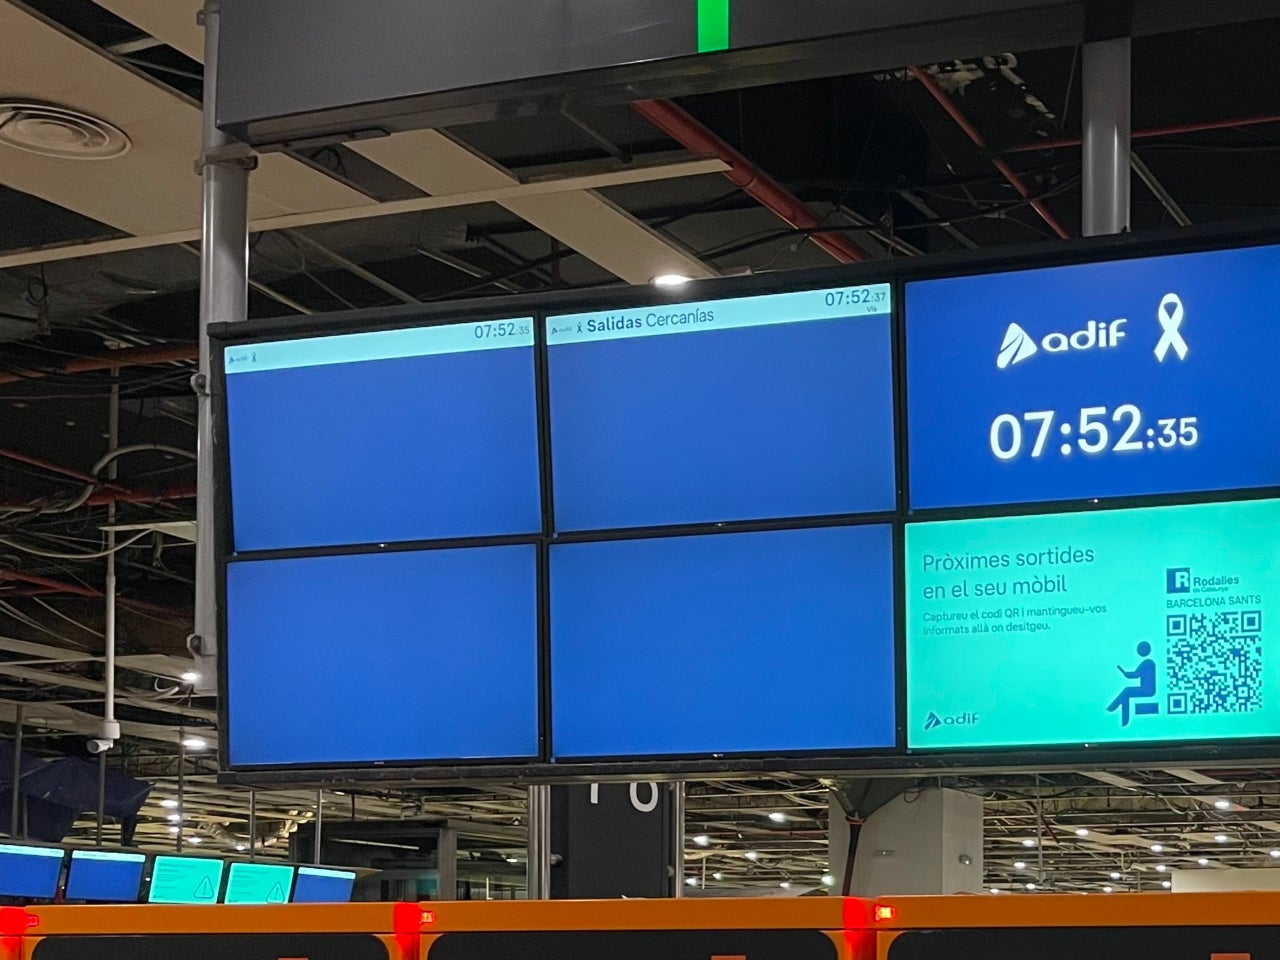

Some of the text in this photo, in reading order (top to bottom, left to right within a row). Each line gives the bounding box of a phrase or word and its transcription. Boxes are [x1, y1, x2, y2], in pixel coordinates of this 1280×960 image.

[825, 288, 886, 307] 07:52:37
[587, 315, 642, 333] Salidas
[645, 308, 715, 329] Cercanías
[474, 322, 530, 339] 07:52:35
[1041, 318, 1128, 352] adif
[989, 404, 1199, 459] 07:52:35
[923, 545, 1095, 572] Pròximes sortides
[923, 574, 1068, 599] en el seu mòbil
[1193, 576, 1240, 587] Rodalies
[1166, 594, 1262, 609] BARCELONA SANTS
[923, 611, 968, 623] Captureu
[970, 609, 980, 620] el
[981, 608, 1004, 620] codi
[1004, 607, 1020, 618] QR
[1026, 604, 1107, 619] mantingueu-vos
[971, 623, 989, 634] allà
[991, 624, 1004, 633] on
[1005, 620, 1052, 633] desitgeu.
[943, 712, 979, 725] adif
